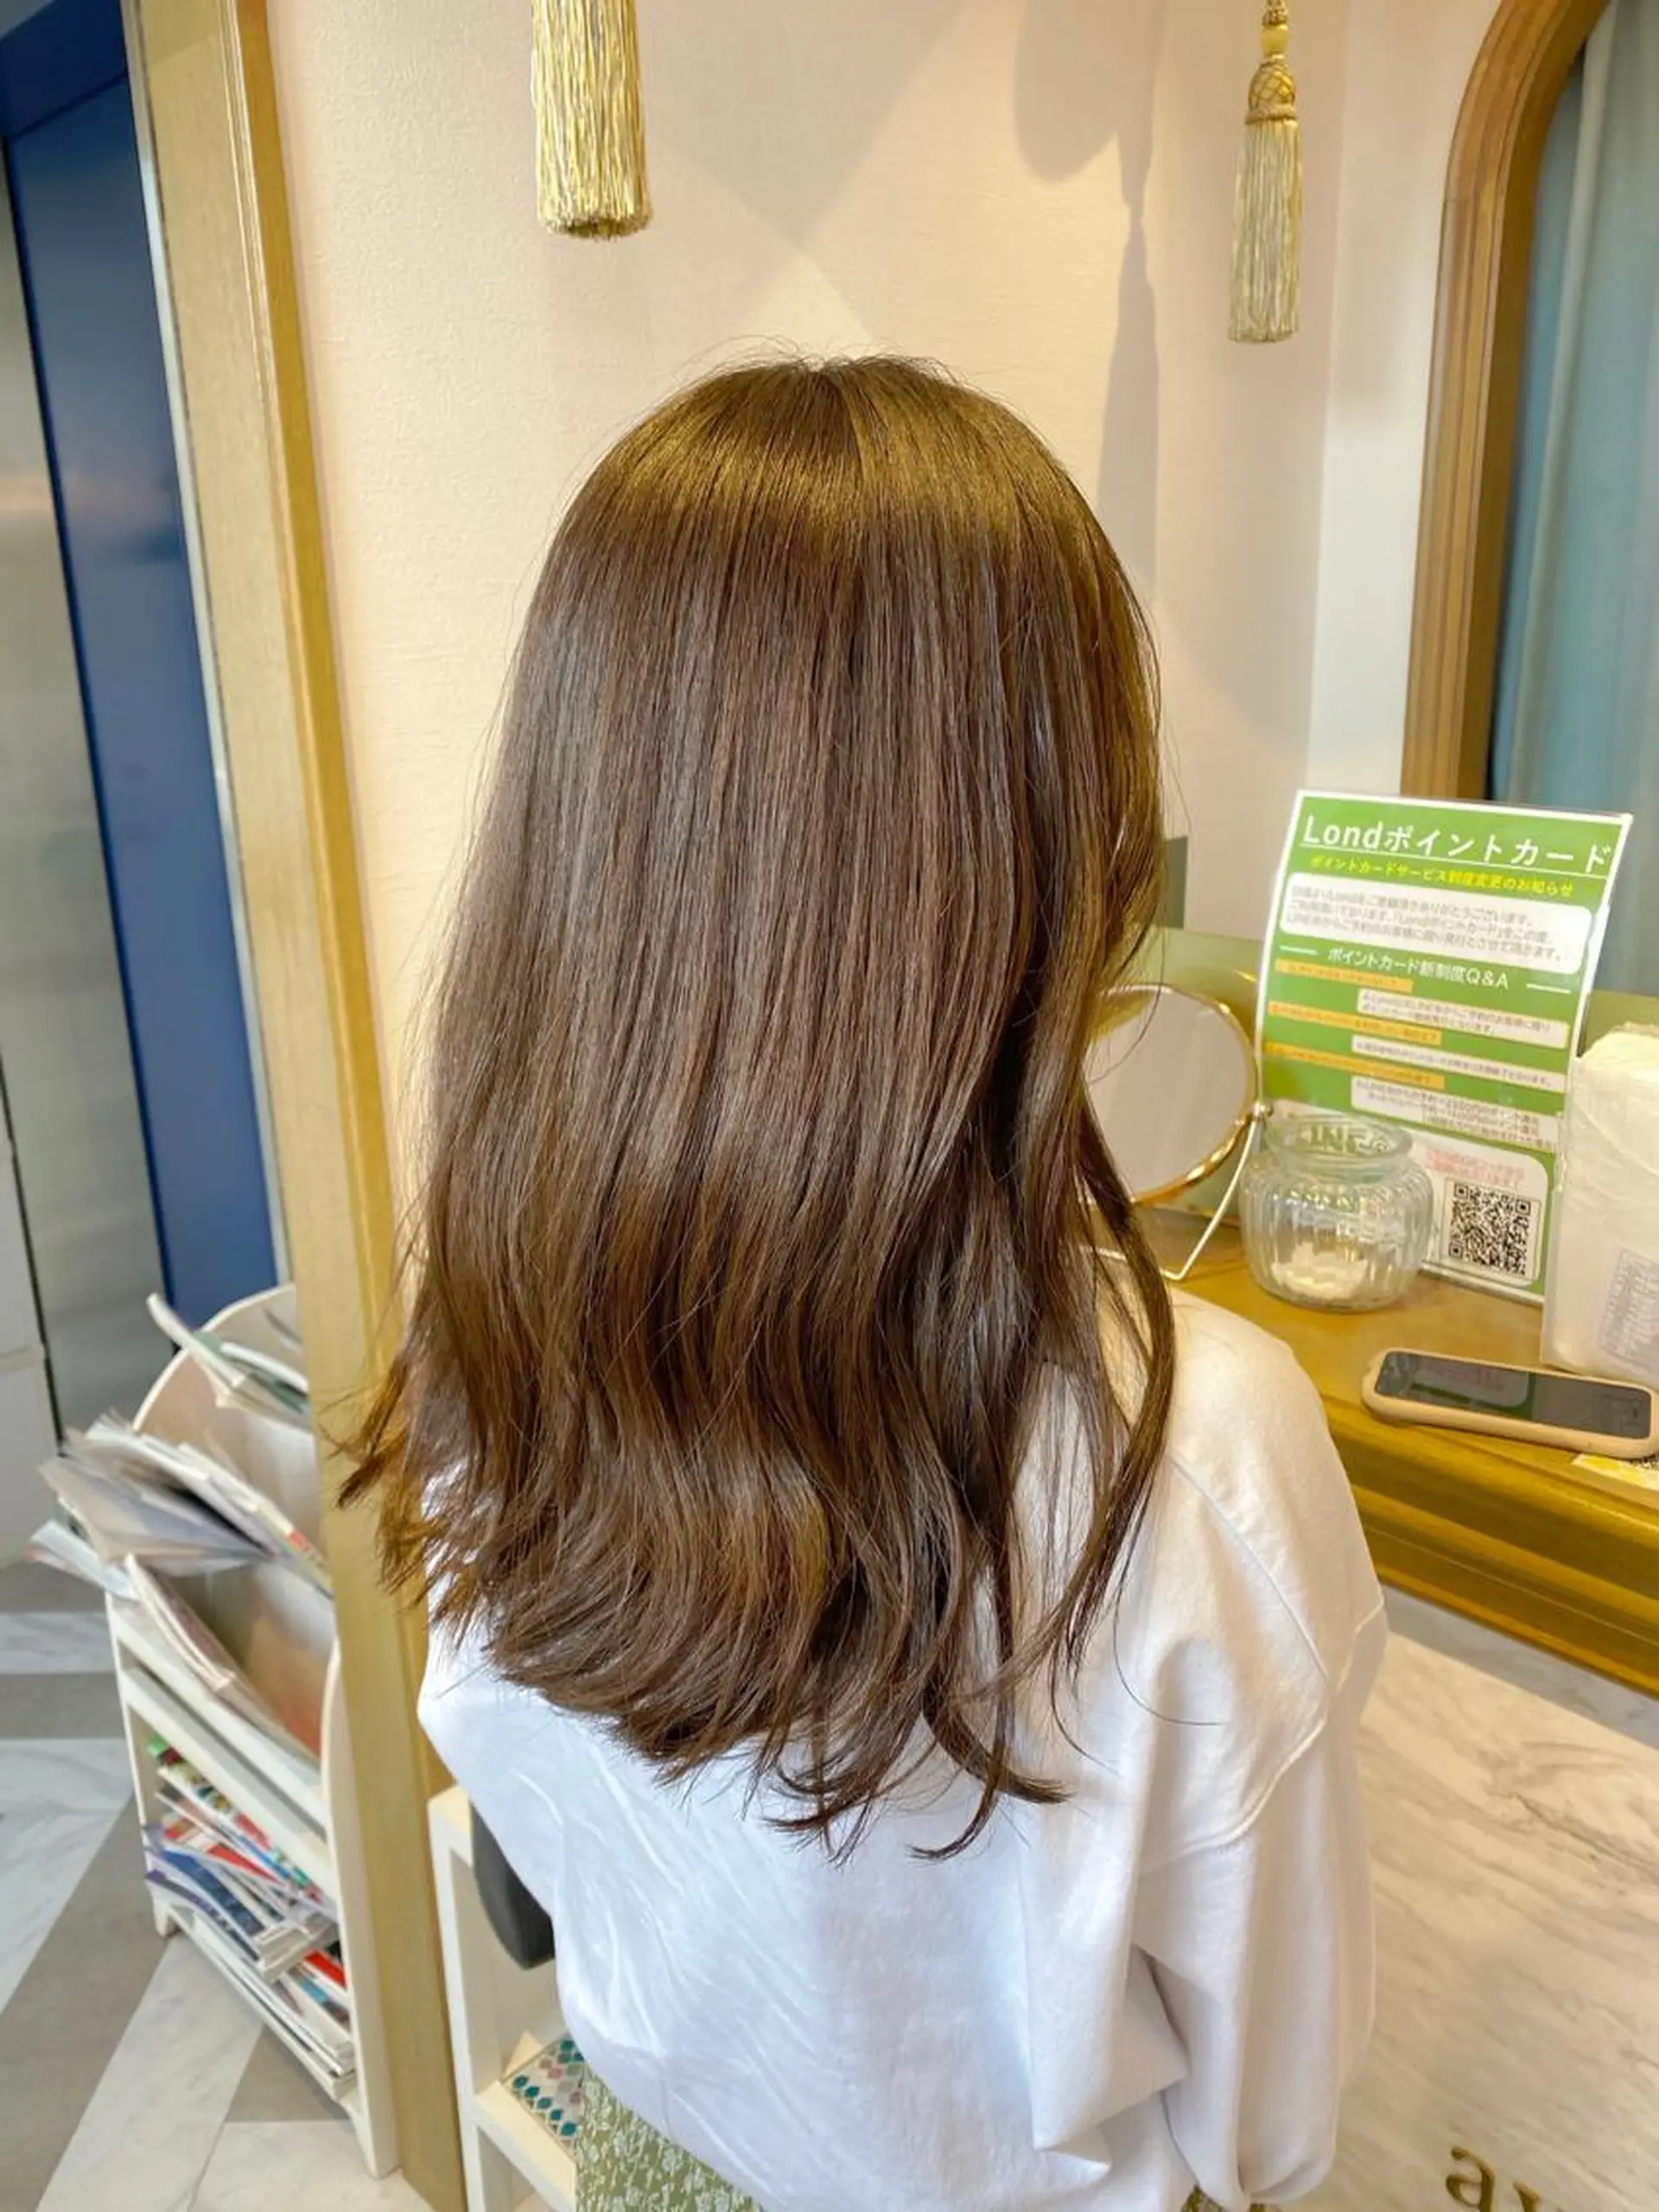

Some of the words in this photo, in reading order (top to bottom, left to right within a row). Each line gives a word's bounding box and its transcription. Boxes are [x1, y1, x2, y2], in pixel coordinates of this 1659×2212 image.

[1301, 815, 1612, 873] Londポイントカード
